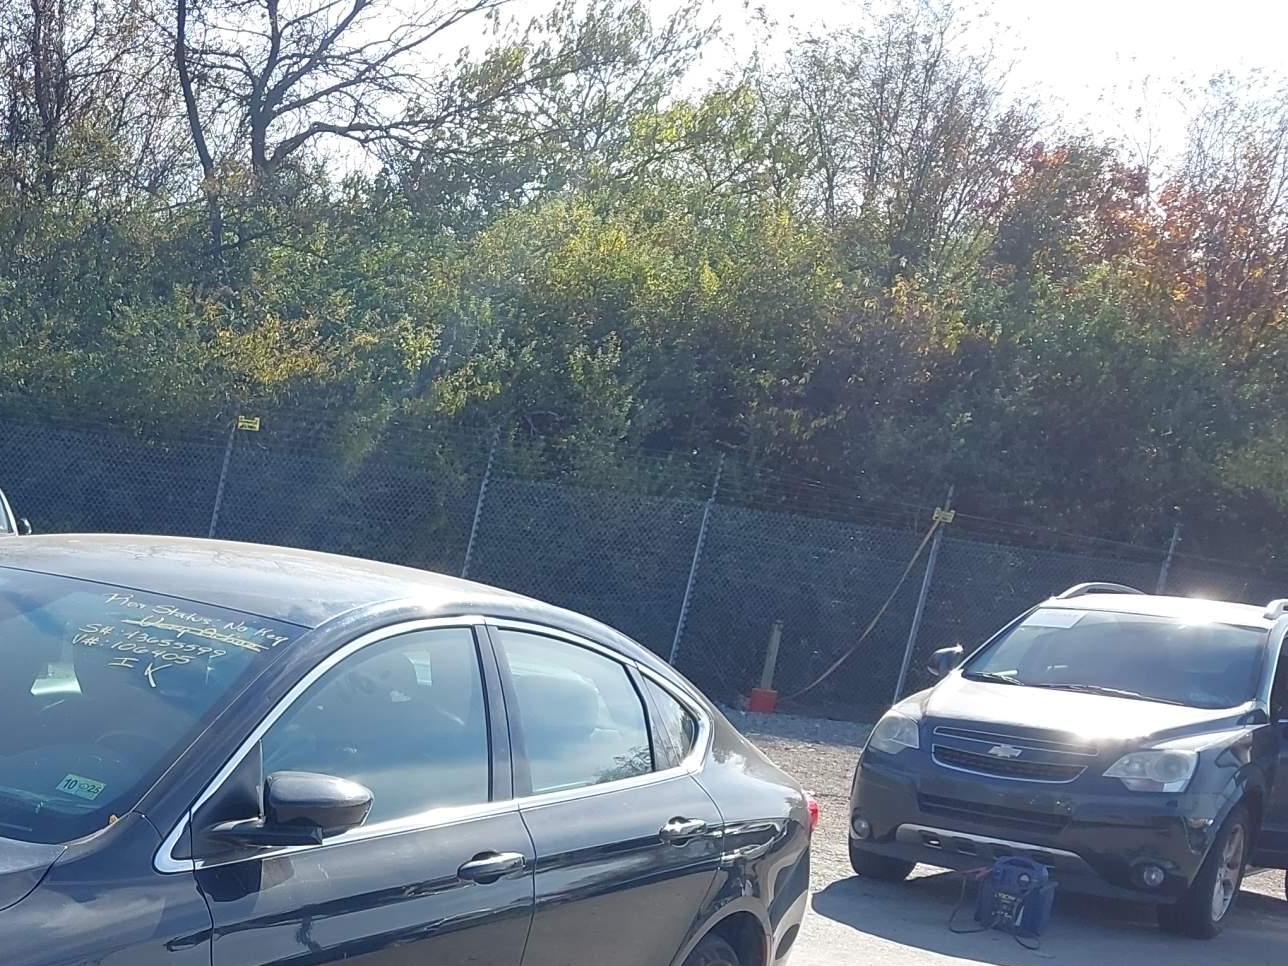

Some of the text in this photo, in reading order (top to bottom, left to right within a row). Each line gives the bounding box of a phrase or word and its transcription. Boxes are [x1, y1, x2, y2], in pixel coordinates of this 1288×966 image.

[223, 621, 249, 633] No
[254, 627, 289, 647] Key
[63, 779, 78, 789] 10
